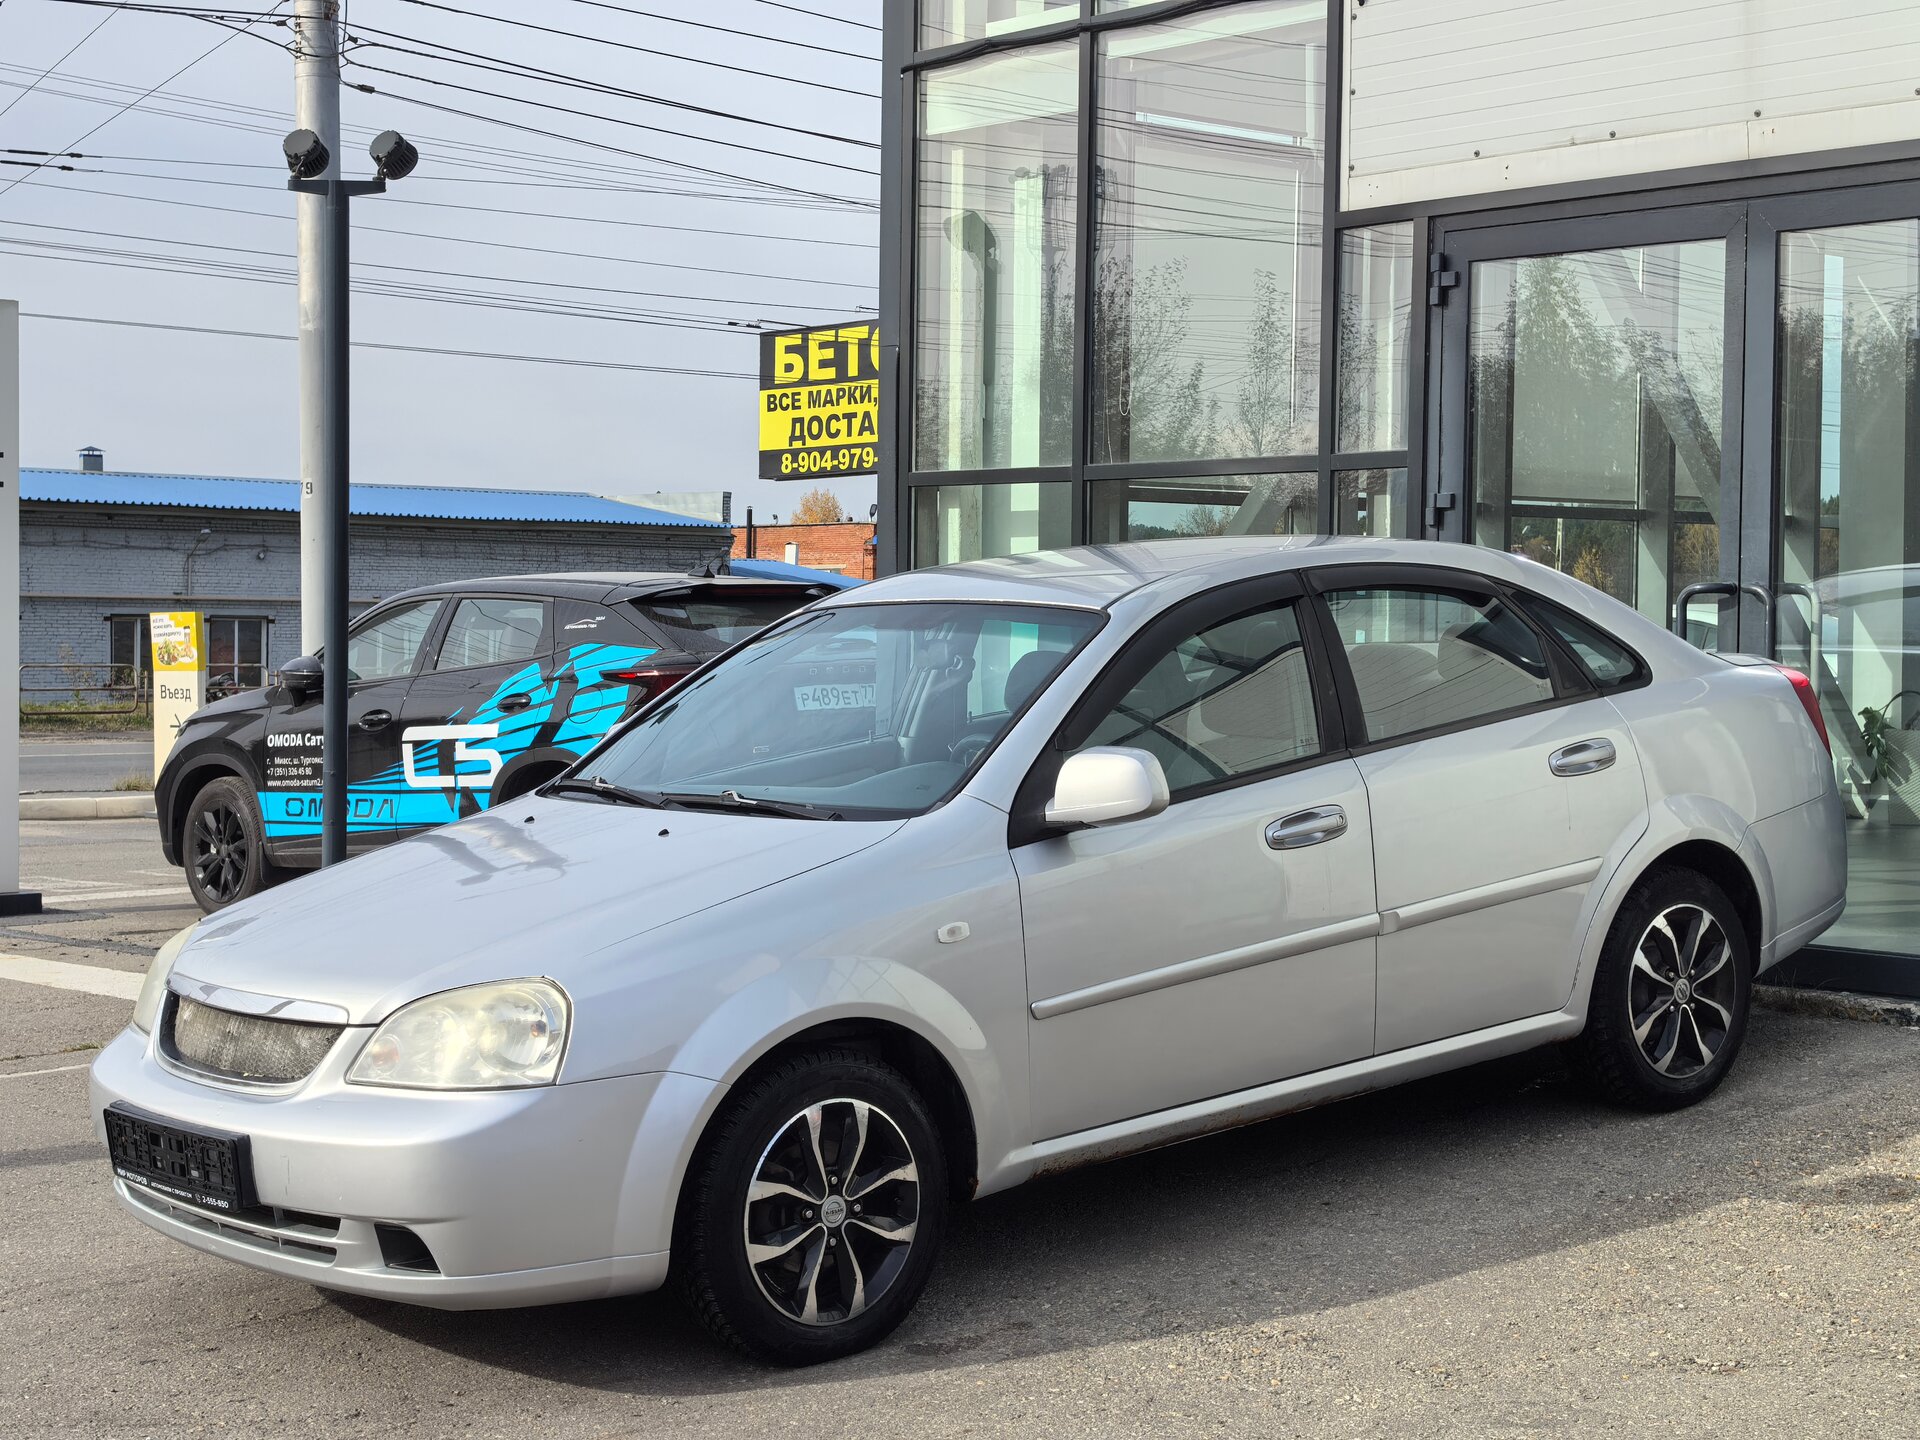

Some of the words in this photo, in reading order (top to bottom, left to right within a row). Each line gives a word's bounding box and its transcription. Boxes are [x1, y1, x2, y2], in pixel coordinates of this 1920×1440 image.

[766, 391, 802, 413] ВСЕ
[807, 384, 878, 409] МАРКИ,
[781, 447, 879, 474] 8-904-979-
[160, 684, 192, 702] Въезд
[267, 733, 303, 747] OMODA
[305, 733, 323, 749] Сату
[274, 756, 293, 765] Миасс,
[267, 767, 274, 776] +7
[275, 767, 288, 777] (351)
[288, 767, 298, 776] 326
[298, 767, 305, 776] 45
[285, 797, 394, 819] OMDA
